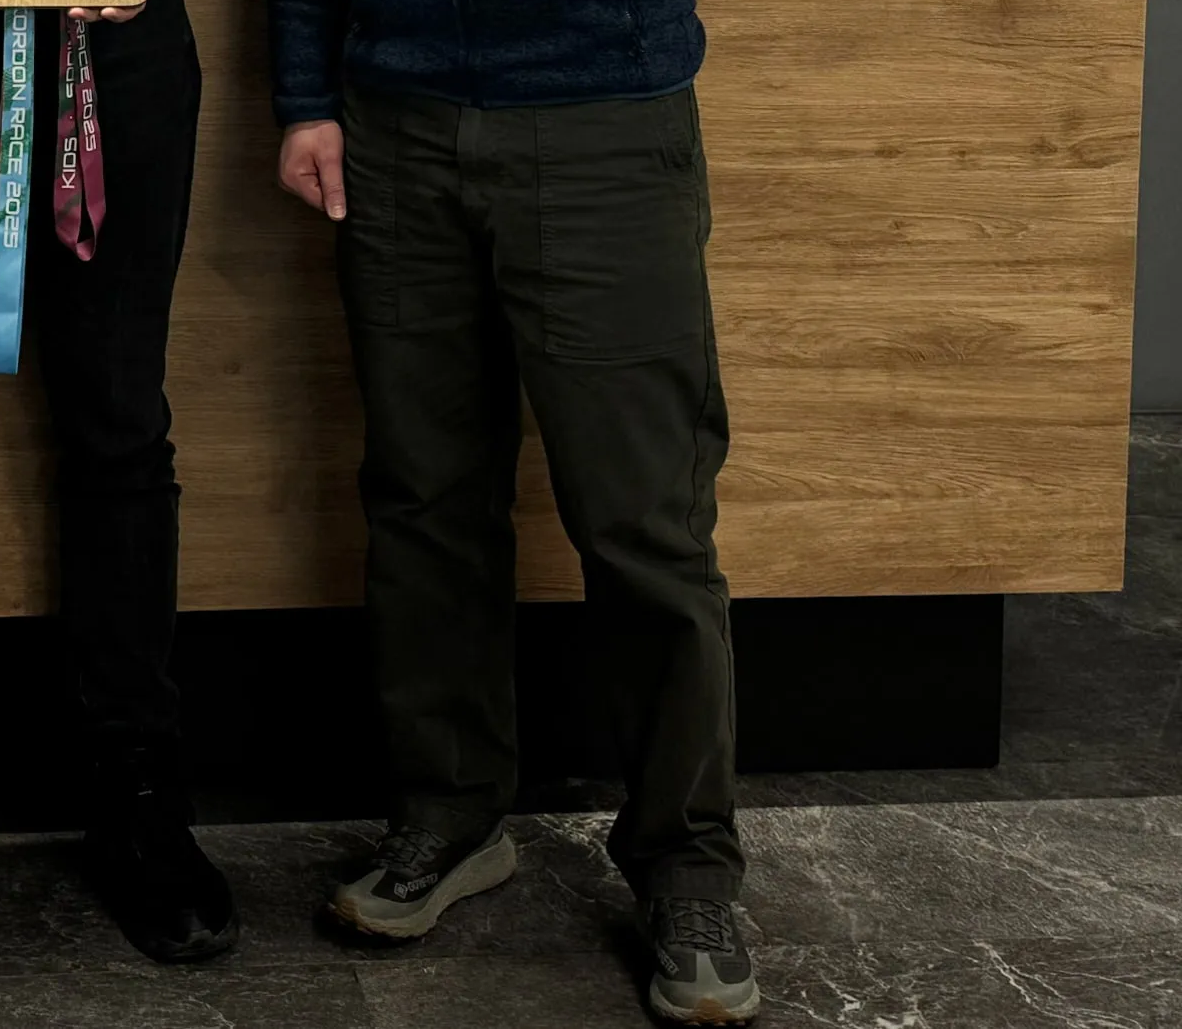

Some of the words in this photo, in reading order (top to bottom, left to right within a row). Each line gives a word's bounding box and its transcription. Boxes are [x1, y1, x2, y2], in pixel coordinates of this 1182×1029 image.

[75, 19, 91, 84] RACE
[7, 107, 26, 176] RACE
[81, 88, 97, 152] 2025
[61, 136, 77, 189] KIDS
[3, 180, 22, 249] 2025
